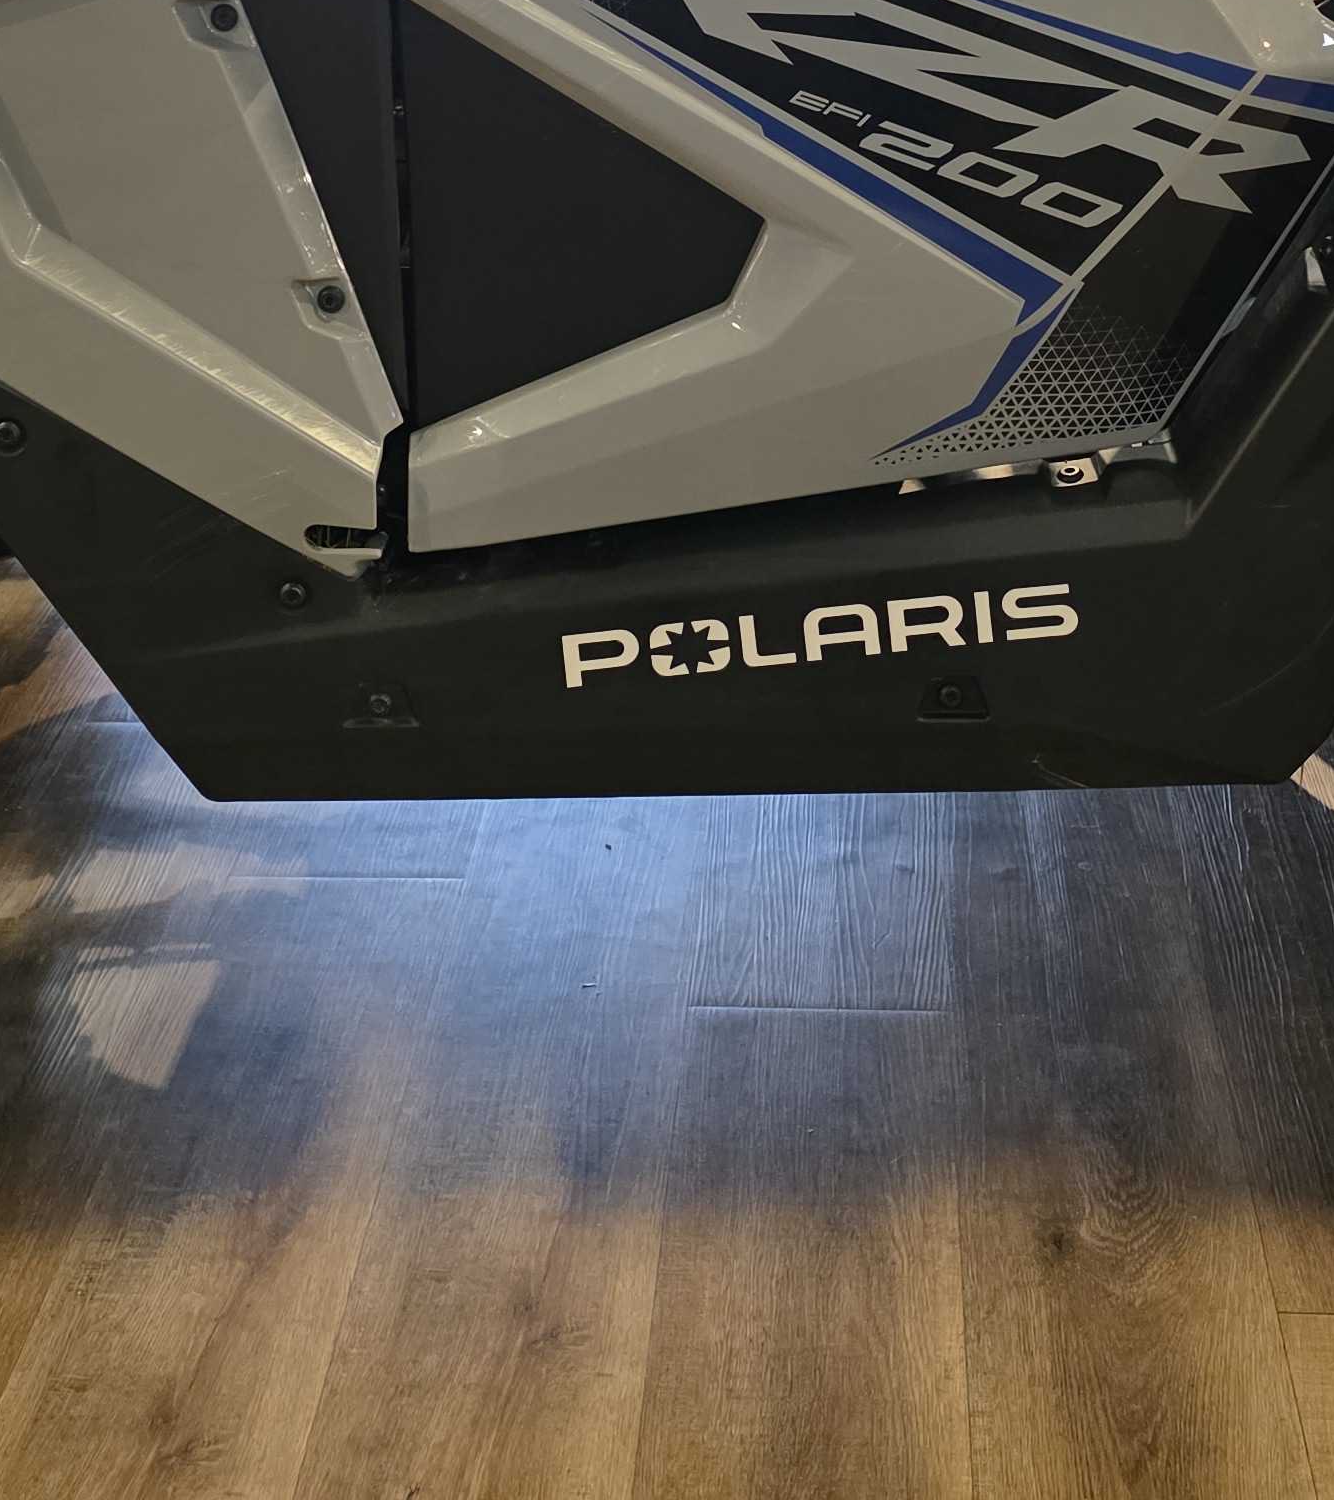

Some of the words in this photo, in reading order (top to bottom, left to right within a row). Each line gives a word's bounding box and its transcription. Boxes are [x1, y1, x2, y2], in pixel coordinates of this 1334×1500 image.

[789, 89, 873, 128] EFI
[859, 126, 1124, 228] 200
[561, 583, 1079, 688] POLARIS
